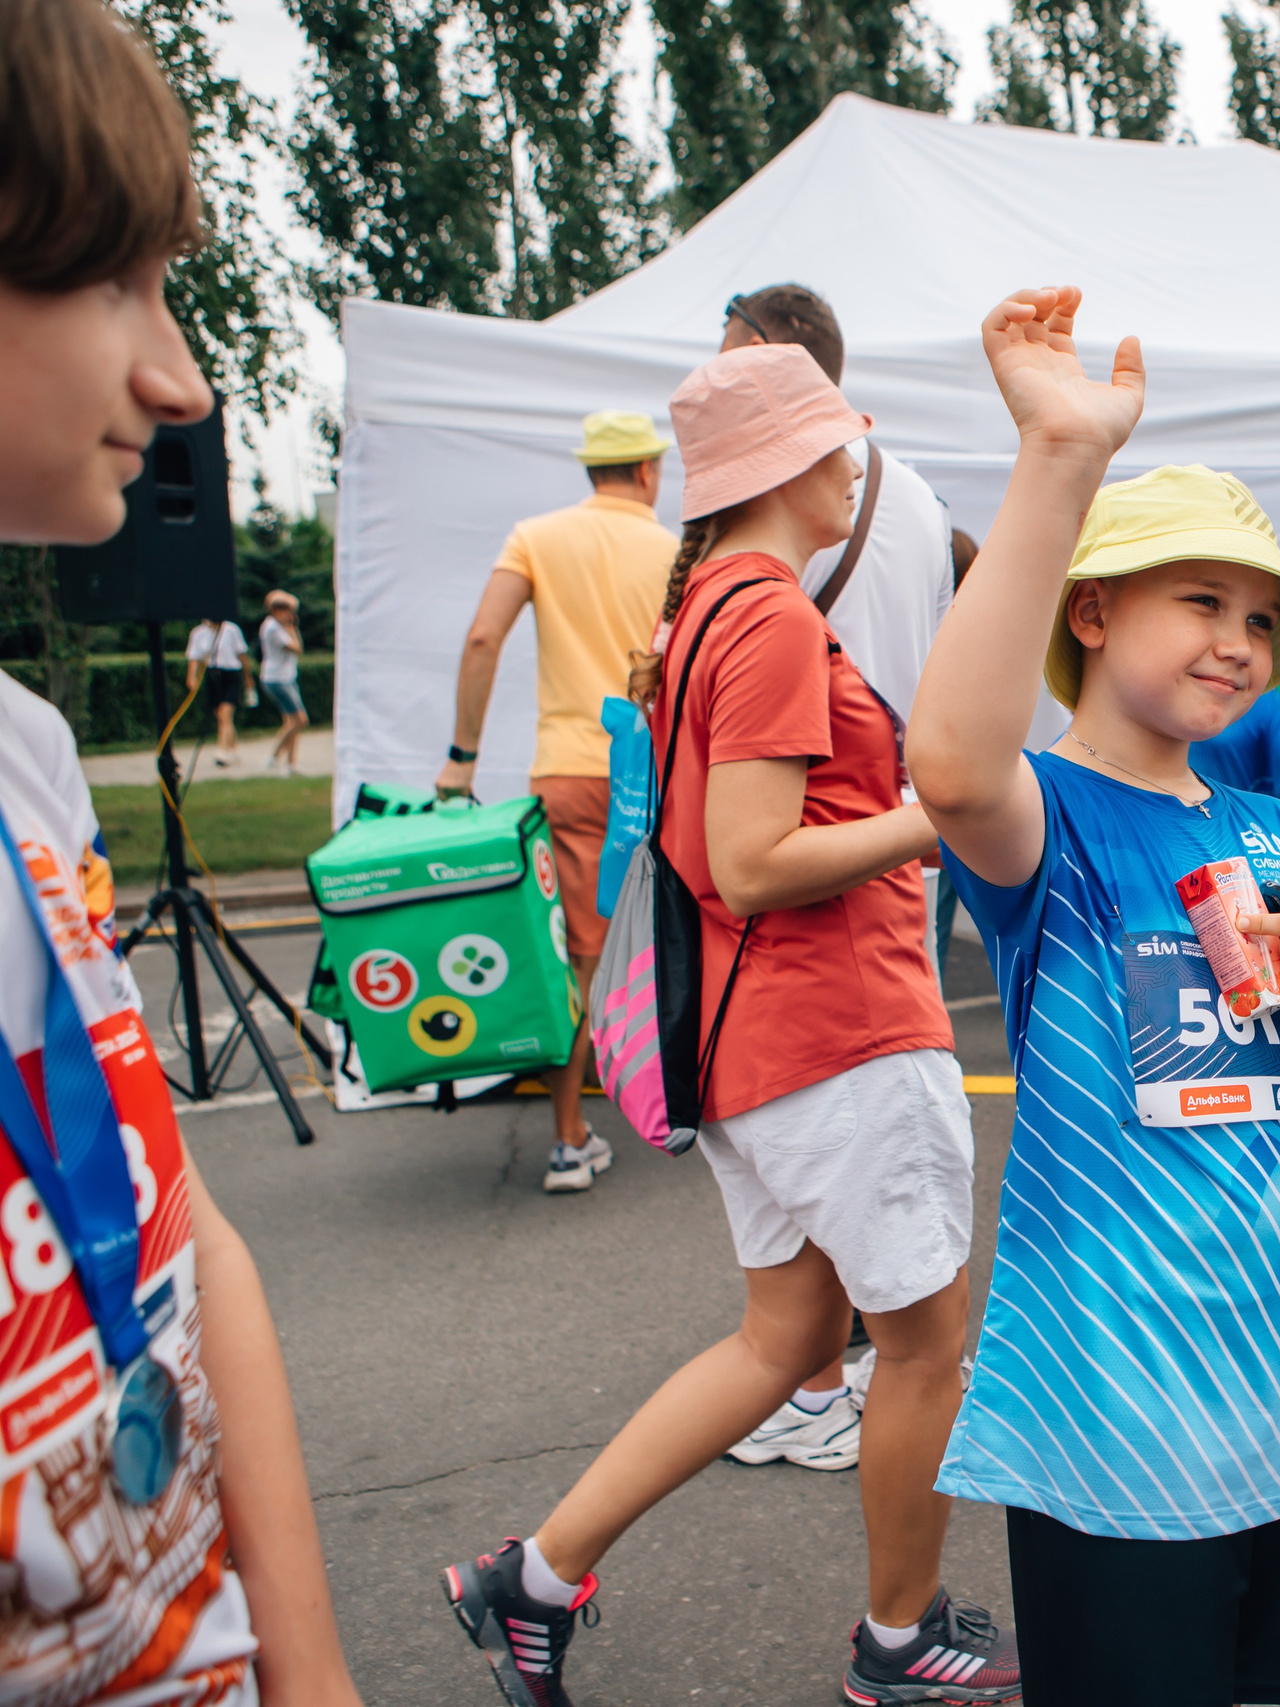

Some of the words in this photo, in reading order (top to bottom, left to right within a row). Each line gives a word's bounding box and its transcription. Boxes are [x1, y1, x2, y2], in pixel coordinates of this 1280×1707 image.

[367, 956, 402, 1002] 5
[1187, 1095, 1221, 1109] Альфа
[1221, 1093, 1246, 1104] Банк
